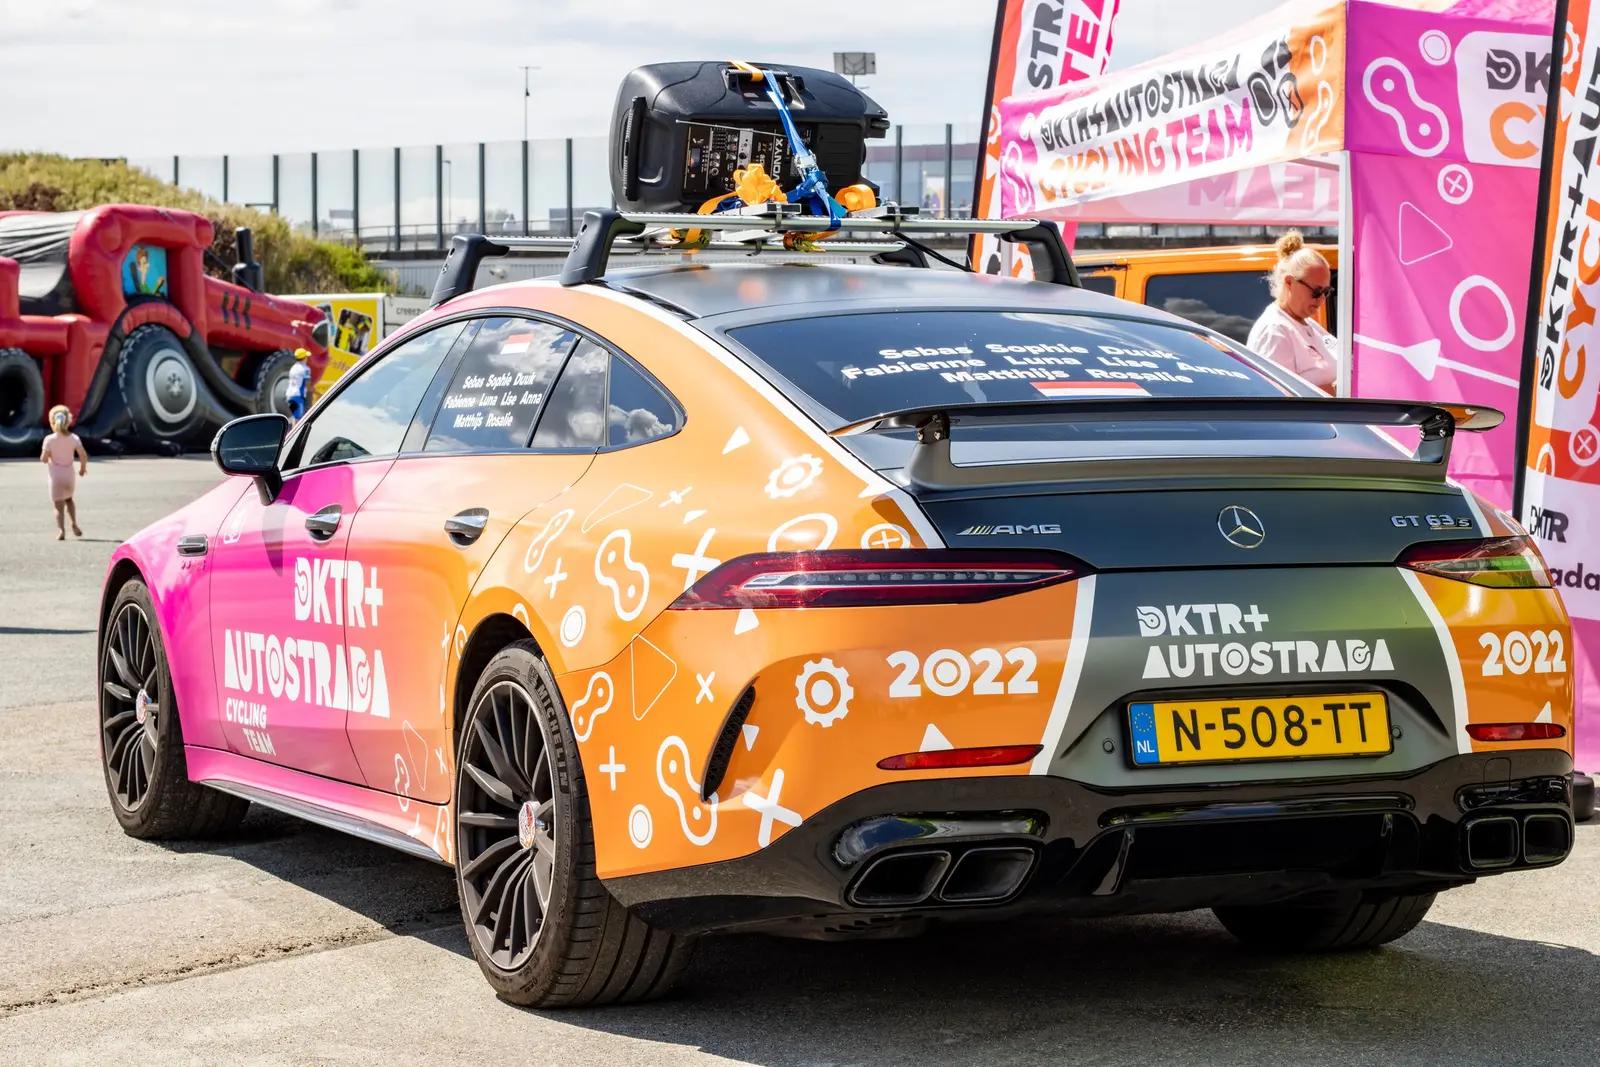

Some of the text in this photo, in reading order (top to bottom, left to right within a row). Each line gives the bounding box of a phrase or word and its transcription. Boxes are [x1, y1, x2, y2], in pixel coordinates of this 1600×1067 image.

[1028, 0, 1064, 90] STR
[1166, 97, 1253, 173] TEAM
[773, 137, 784, 182] VONYX
[840, 355, 1251, 380] Fabienne Luna Lise Anna
[877, 343, 1180, 360] Sebas Sophie Duuk
[462, 371, 536, 390] Sebas Sophie Duuk
[939, 368, 1194, 384] Matthijs Rosalie
[443, 390, 543, 409] Fabienne Luna Lise Anna
[453, 411, 514, 431] Matthijs Rosalie
[990, 523, 1062, 535] AMG
[1391, 515, 1420, 528] GT
[1425, 514, 1455, 528] 63
[1529, 504, 1569, 543] DKTR
[294, 556, 384, 629] DKTR+
[1136, 603, 1270, 638] DKTR+
[1141, 638, 1395, 679] AUTOSTRADA
[1478, 629, 1567, 677] 2022
[224, 628, 391, 719] AUTOSTRADA
[885, 646, 1039, 699] 2022
[225, 697, 268, 728] CYCLING
[1171, 702, 1371, 752] N-508-TT
[242, 727, 277, 757] TEAM
[537, 682, 569, 789] MICHELIN
[1137, 740, 1155, 754] NL
